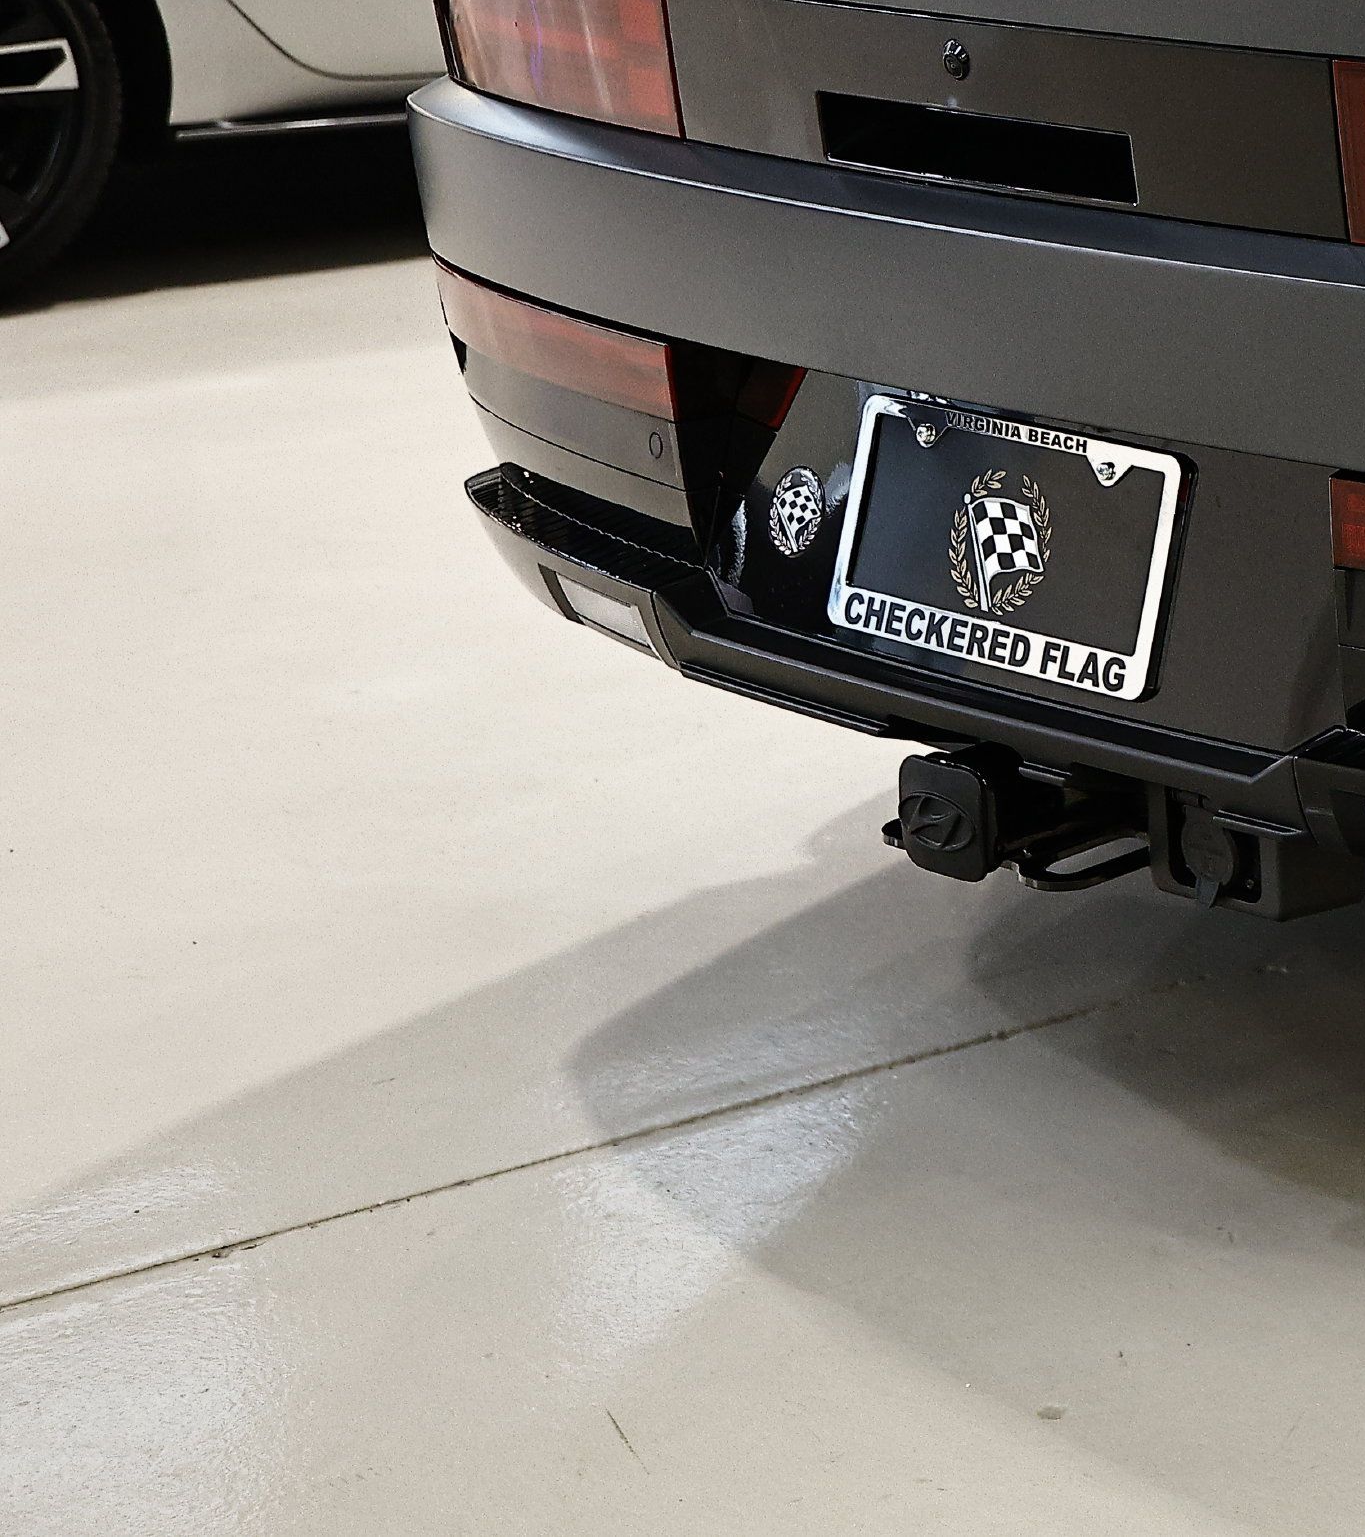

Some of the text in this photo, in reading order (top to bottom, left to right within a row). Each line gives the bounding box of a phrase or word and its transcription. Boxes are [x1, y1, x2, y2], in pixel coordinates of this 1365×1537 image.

[945, 411, 1088, 454] VIRGINIA BEACH
[845, 592, 1127, 692] CHECKERED FLAG
